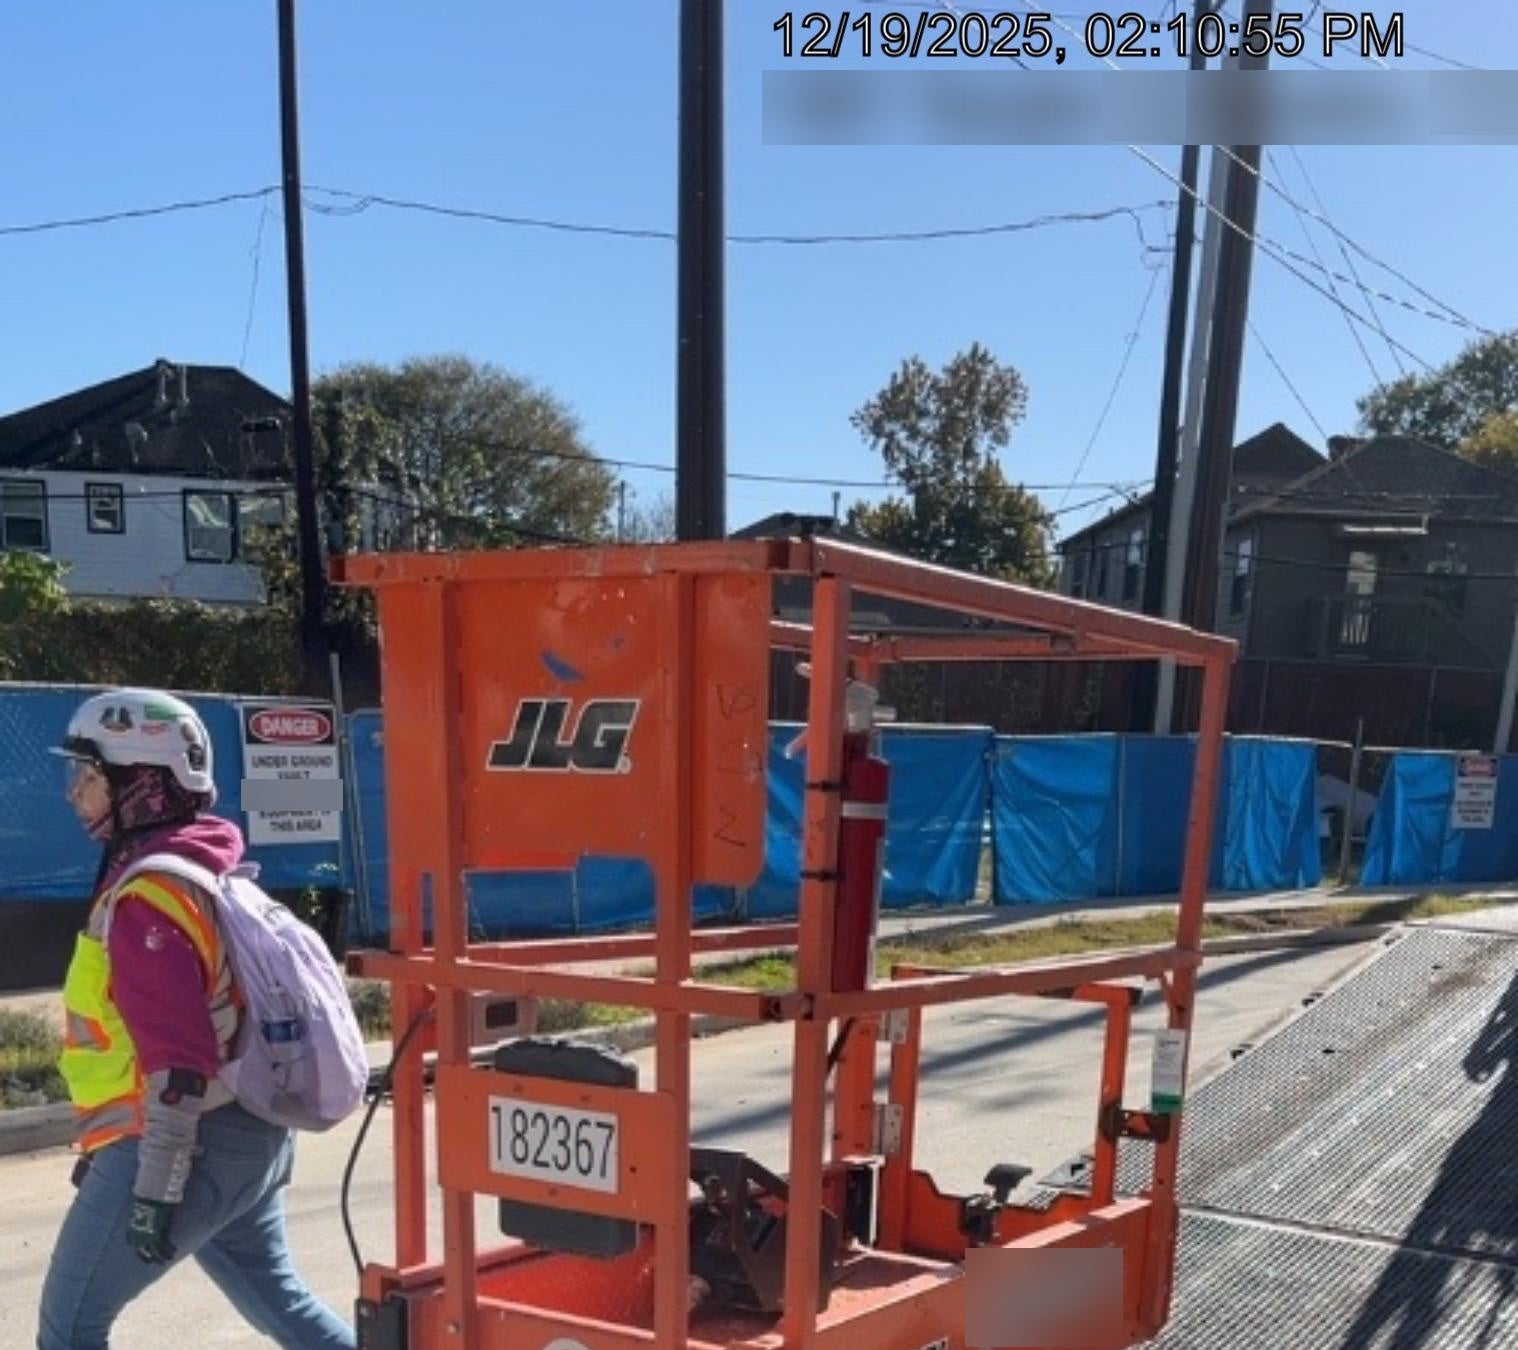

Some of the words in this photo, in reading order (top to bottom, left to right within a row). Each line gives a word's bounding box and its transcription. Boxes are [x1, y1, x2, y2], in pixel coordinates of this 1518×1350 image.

[261, 716, 319, 736] DANGER
[486, 699, 641, 774] JLG
[491, 1106, 615, 1179] 182367
